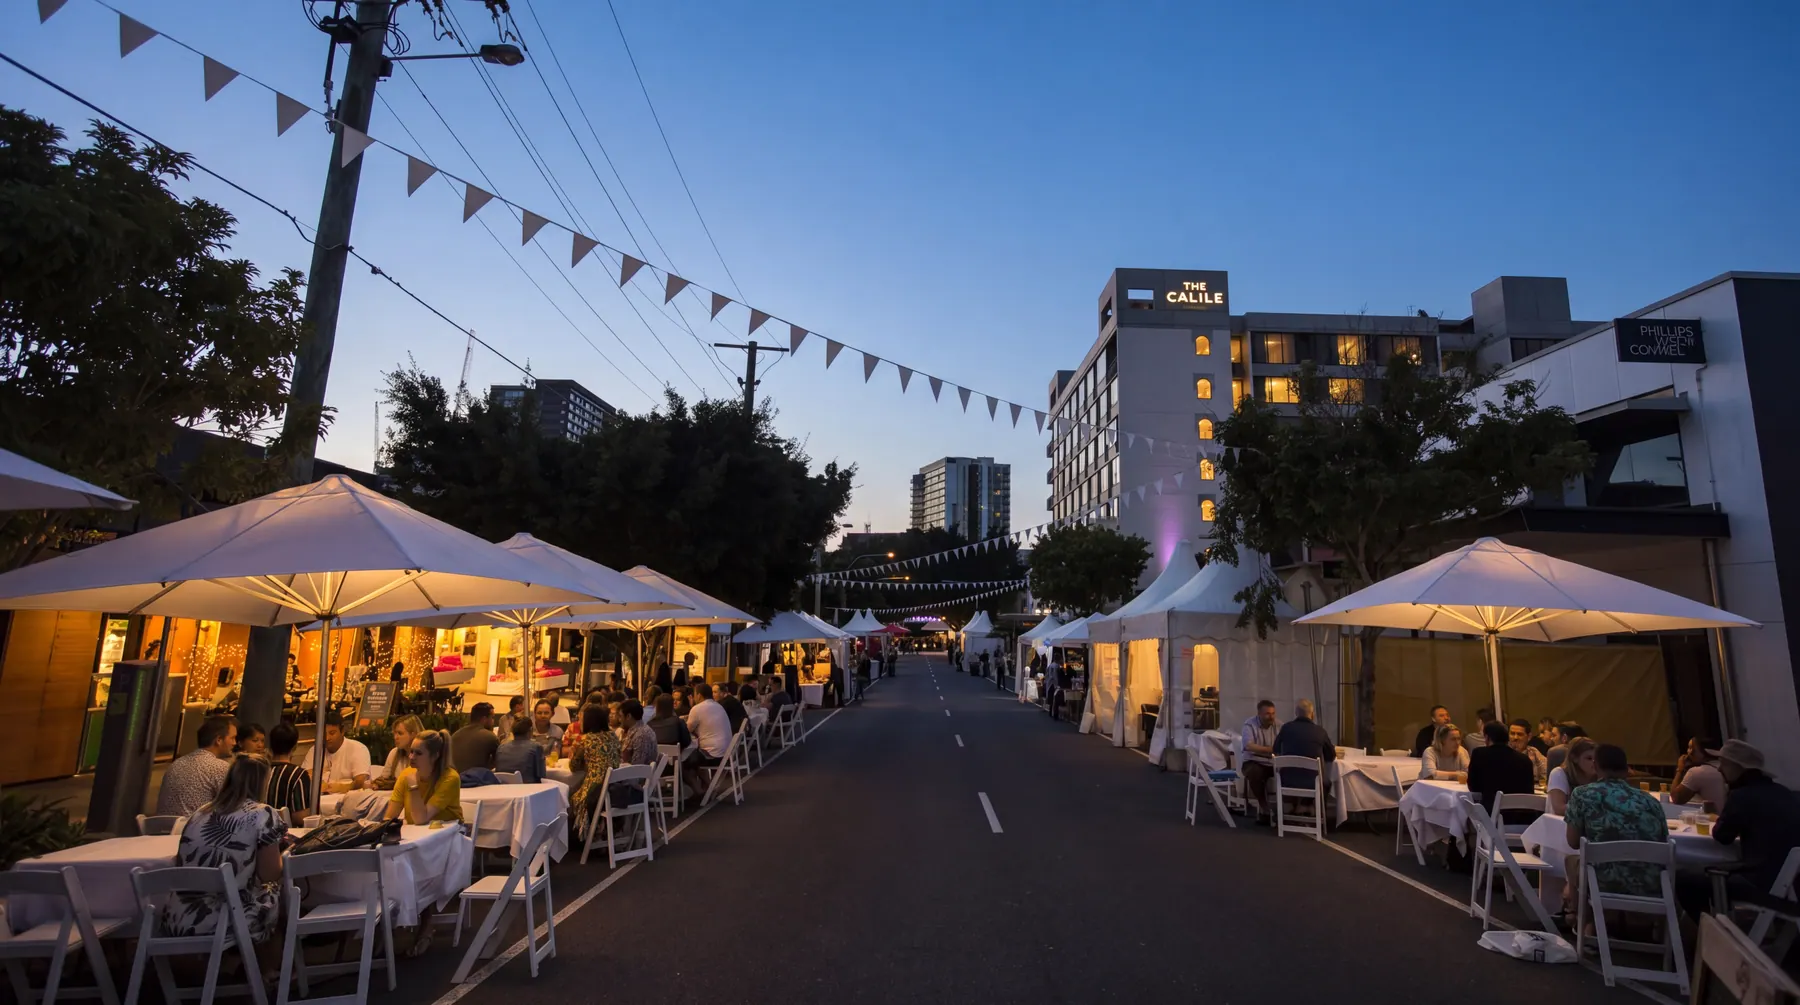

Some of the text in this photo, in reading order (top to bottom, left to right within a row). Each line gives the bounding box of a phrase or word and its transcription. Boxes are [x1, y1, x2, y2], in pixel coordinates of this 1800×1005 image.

[1183, 282, 1206, 291] THE
[1166, 291, 1223, 304] CALILE
[1640, 325, 1694, 337] PHILLIPS
